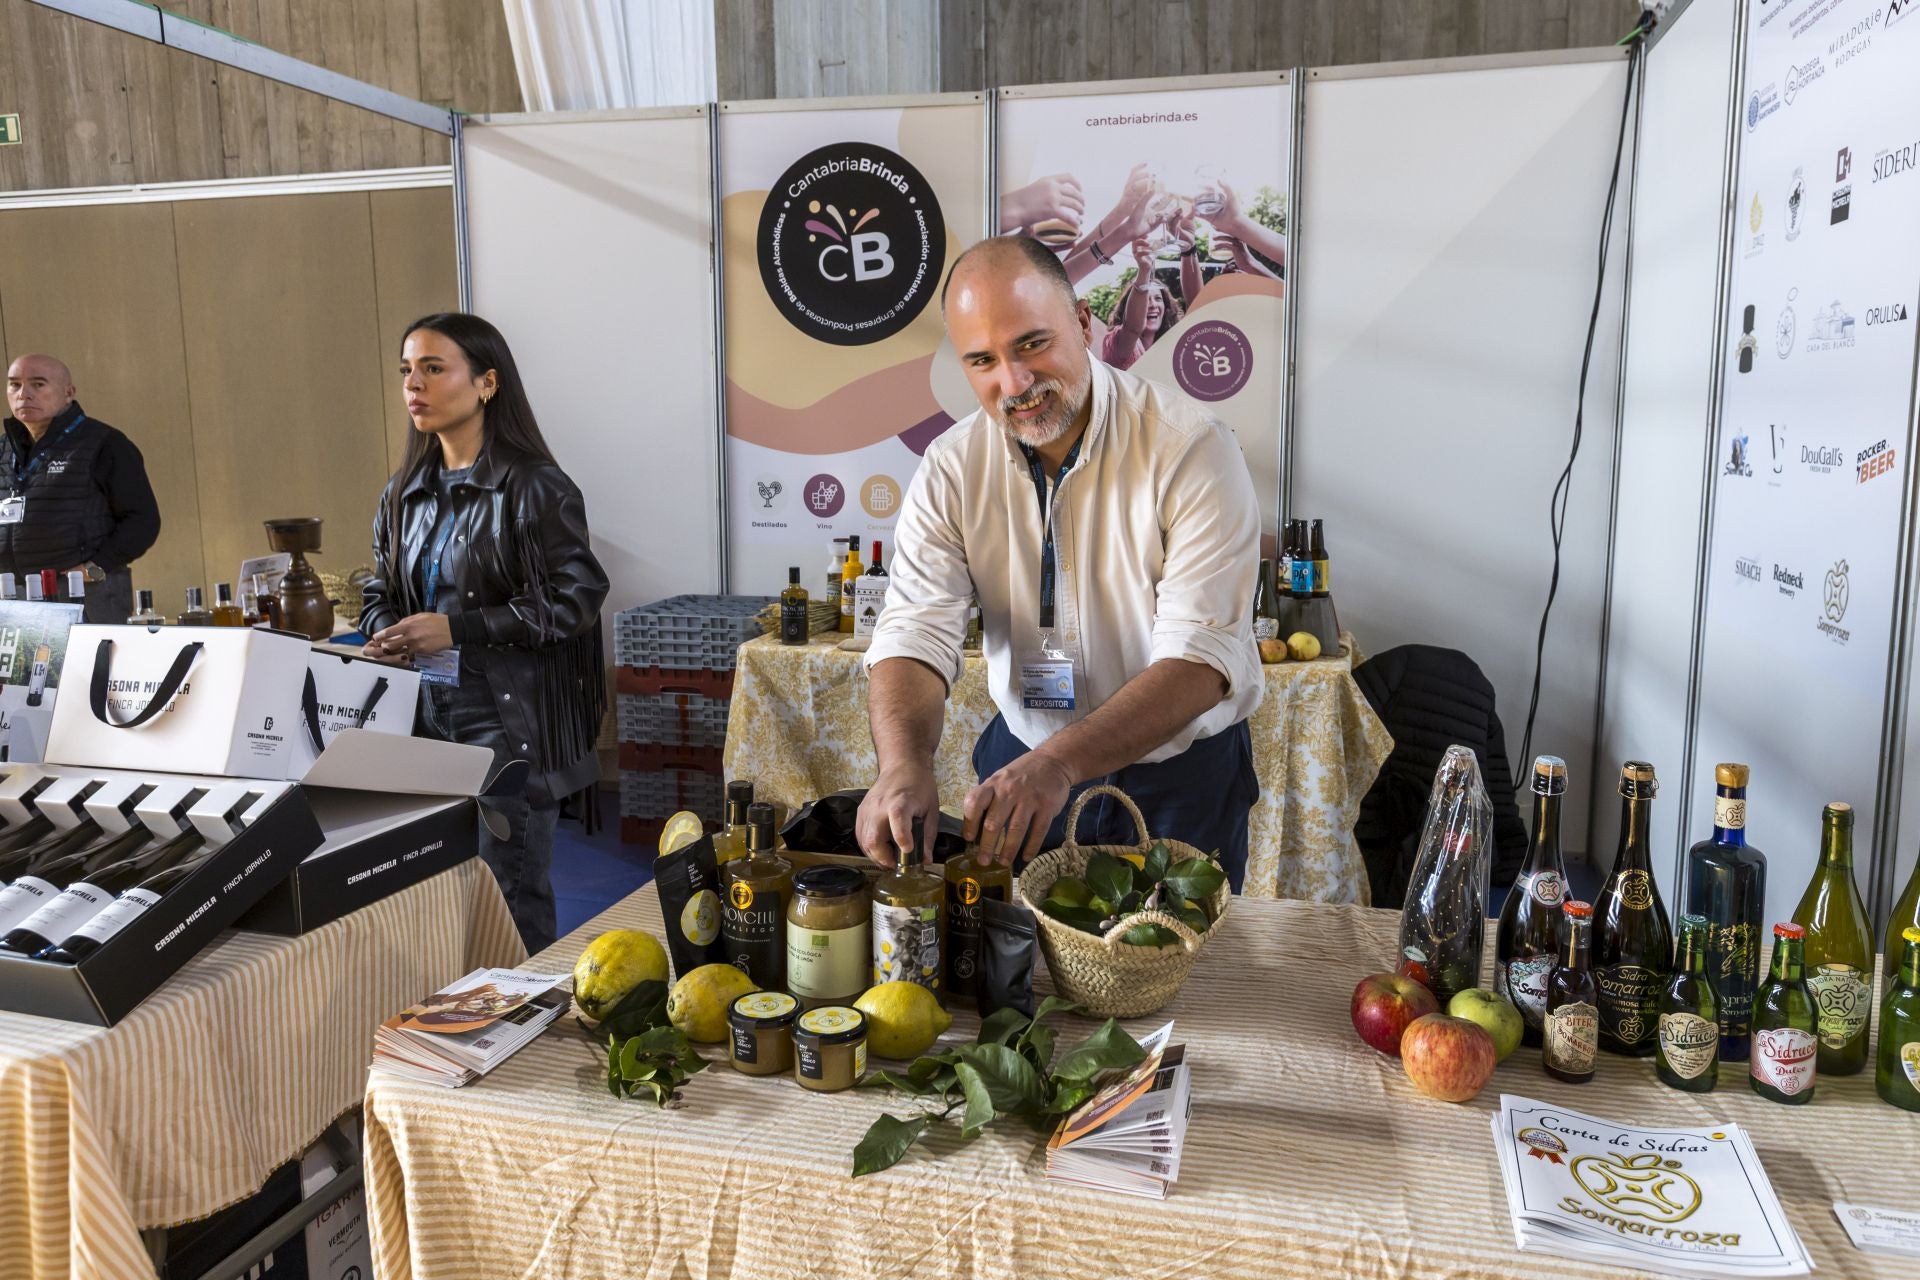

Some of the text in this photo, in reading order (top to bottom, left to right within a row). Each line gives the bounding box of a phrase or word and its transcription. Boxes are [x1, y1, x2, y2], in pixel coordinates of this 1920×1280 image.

[1085, 112, 1199, 127] cantabriabrinda.es
[788, 156, 911, 198] CantabriaBrinda
[772, 209, 931, 331] Asociación Cántabra de Empresas Productoras de Bebidas Alcohólicas
[1801, 445, 1843, 467] DouGall's
[1857, 439, 1887, 463] ROCKER
[1860, 449, 1896, 484] BEER
[1773, 564, 1803, 589] Redneck
[1816, 616, 1850, 641] Somarroza
[1030, 700, 1069, 708] EXPOSITOR
[347, 840, 443, 885] CASONA MICAELA FINCA JORNILLO
[155, 849, 272, 951] CASONA MICAELA FINCA JORNILLO
[1618, 968, 1648, 982] Sidra
[1816, 976, 1834, 985] SIDRA
[1566, 1016, 1593, 1028] BITER
[1665, 1020, 1718, 1043] Sidruca
[1764, 1036, 1817, 1059] Sidruca
[1775, 1066, 1806, 1075] Dulce
[1539, 1116, 1600, 1142] Carta
[1608, 1133, 1630, 1147] de
[1638, 1136, 1709, 1154] Sidras
[328, 1215, 361, 1248] VERMOUTH
[1557, 1196, 1741, 1248] Somarroza
